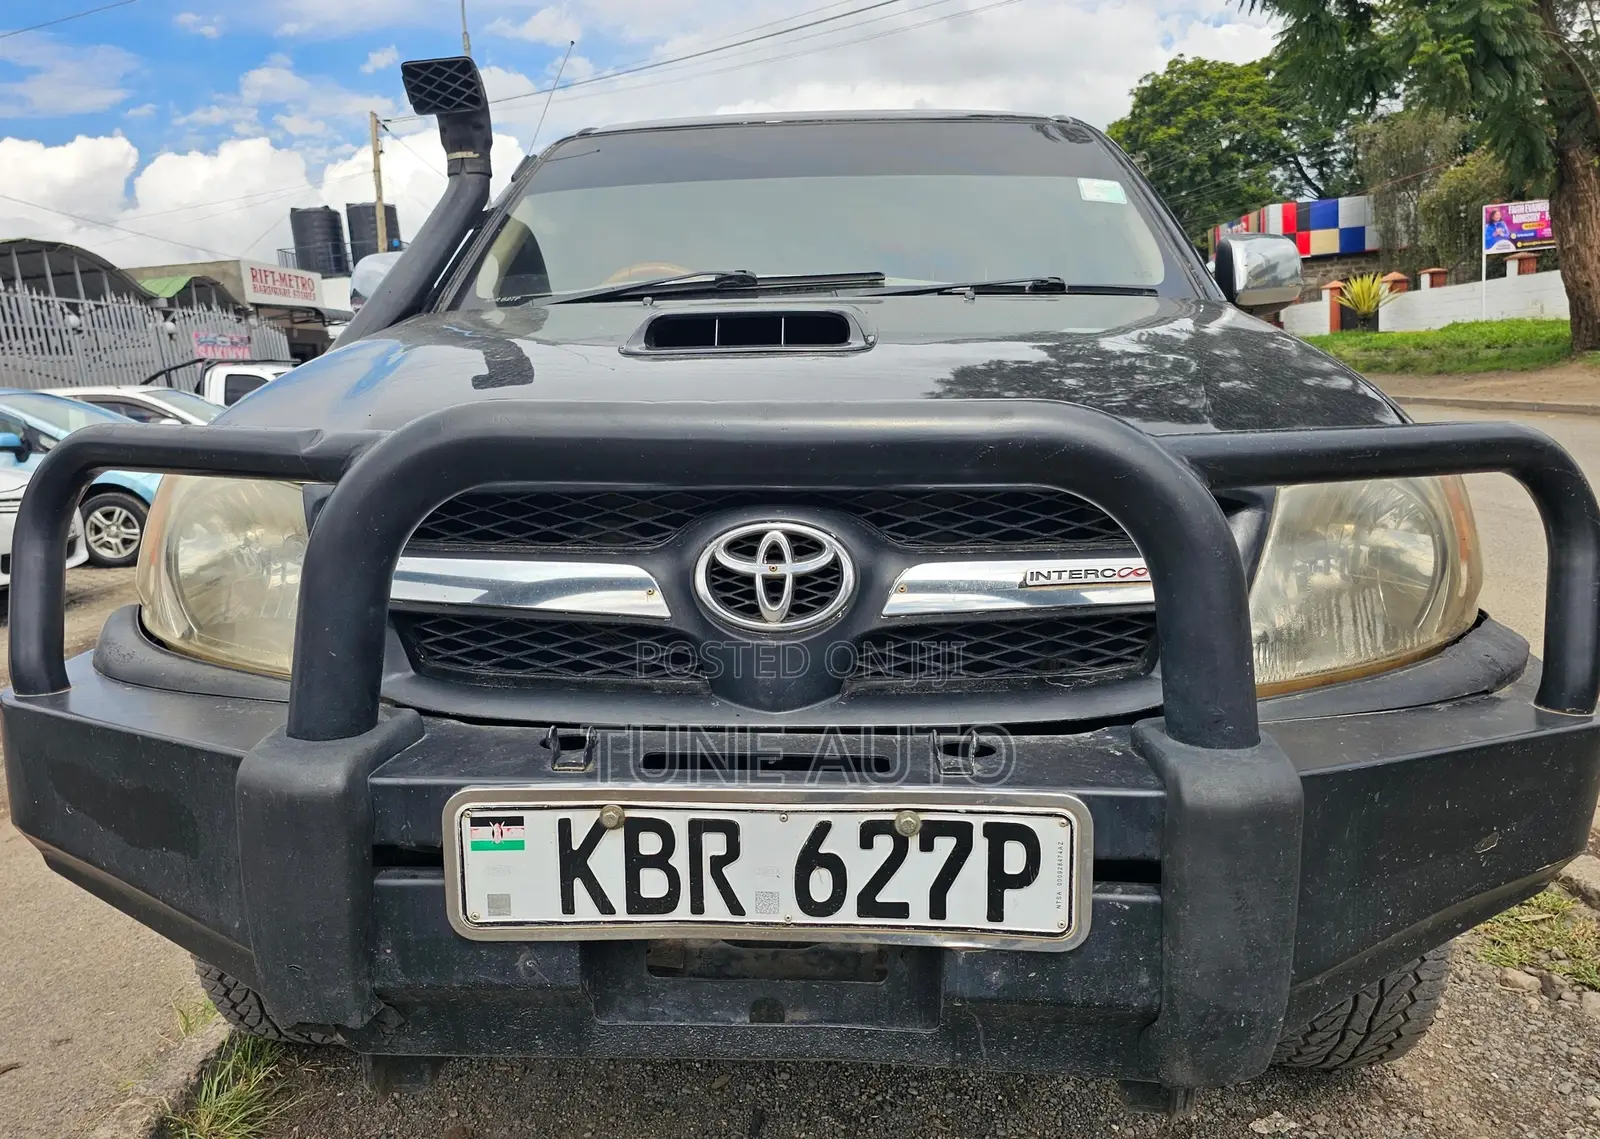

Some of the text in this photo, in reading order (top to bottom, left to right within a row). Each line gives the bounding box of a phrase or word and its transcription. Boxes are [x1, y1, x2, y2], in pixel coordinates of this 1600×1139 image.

[250, 267, 315, 293] RIFT-METRO
[252, 283, 316, 301] HARDWARE STORES
[1029, 567, 1148, 582] INTERCOO
[557, 816, 1042, 923] KBR 627P
